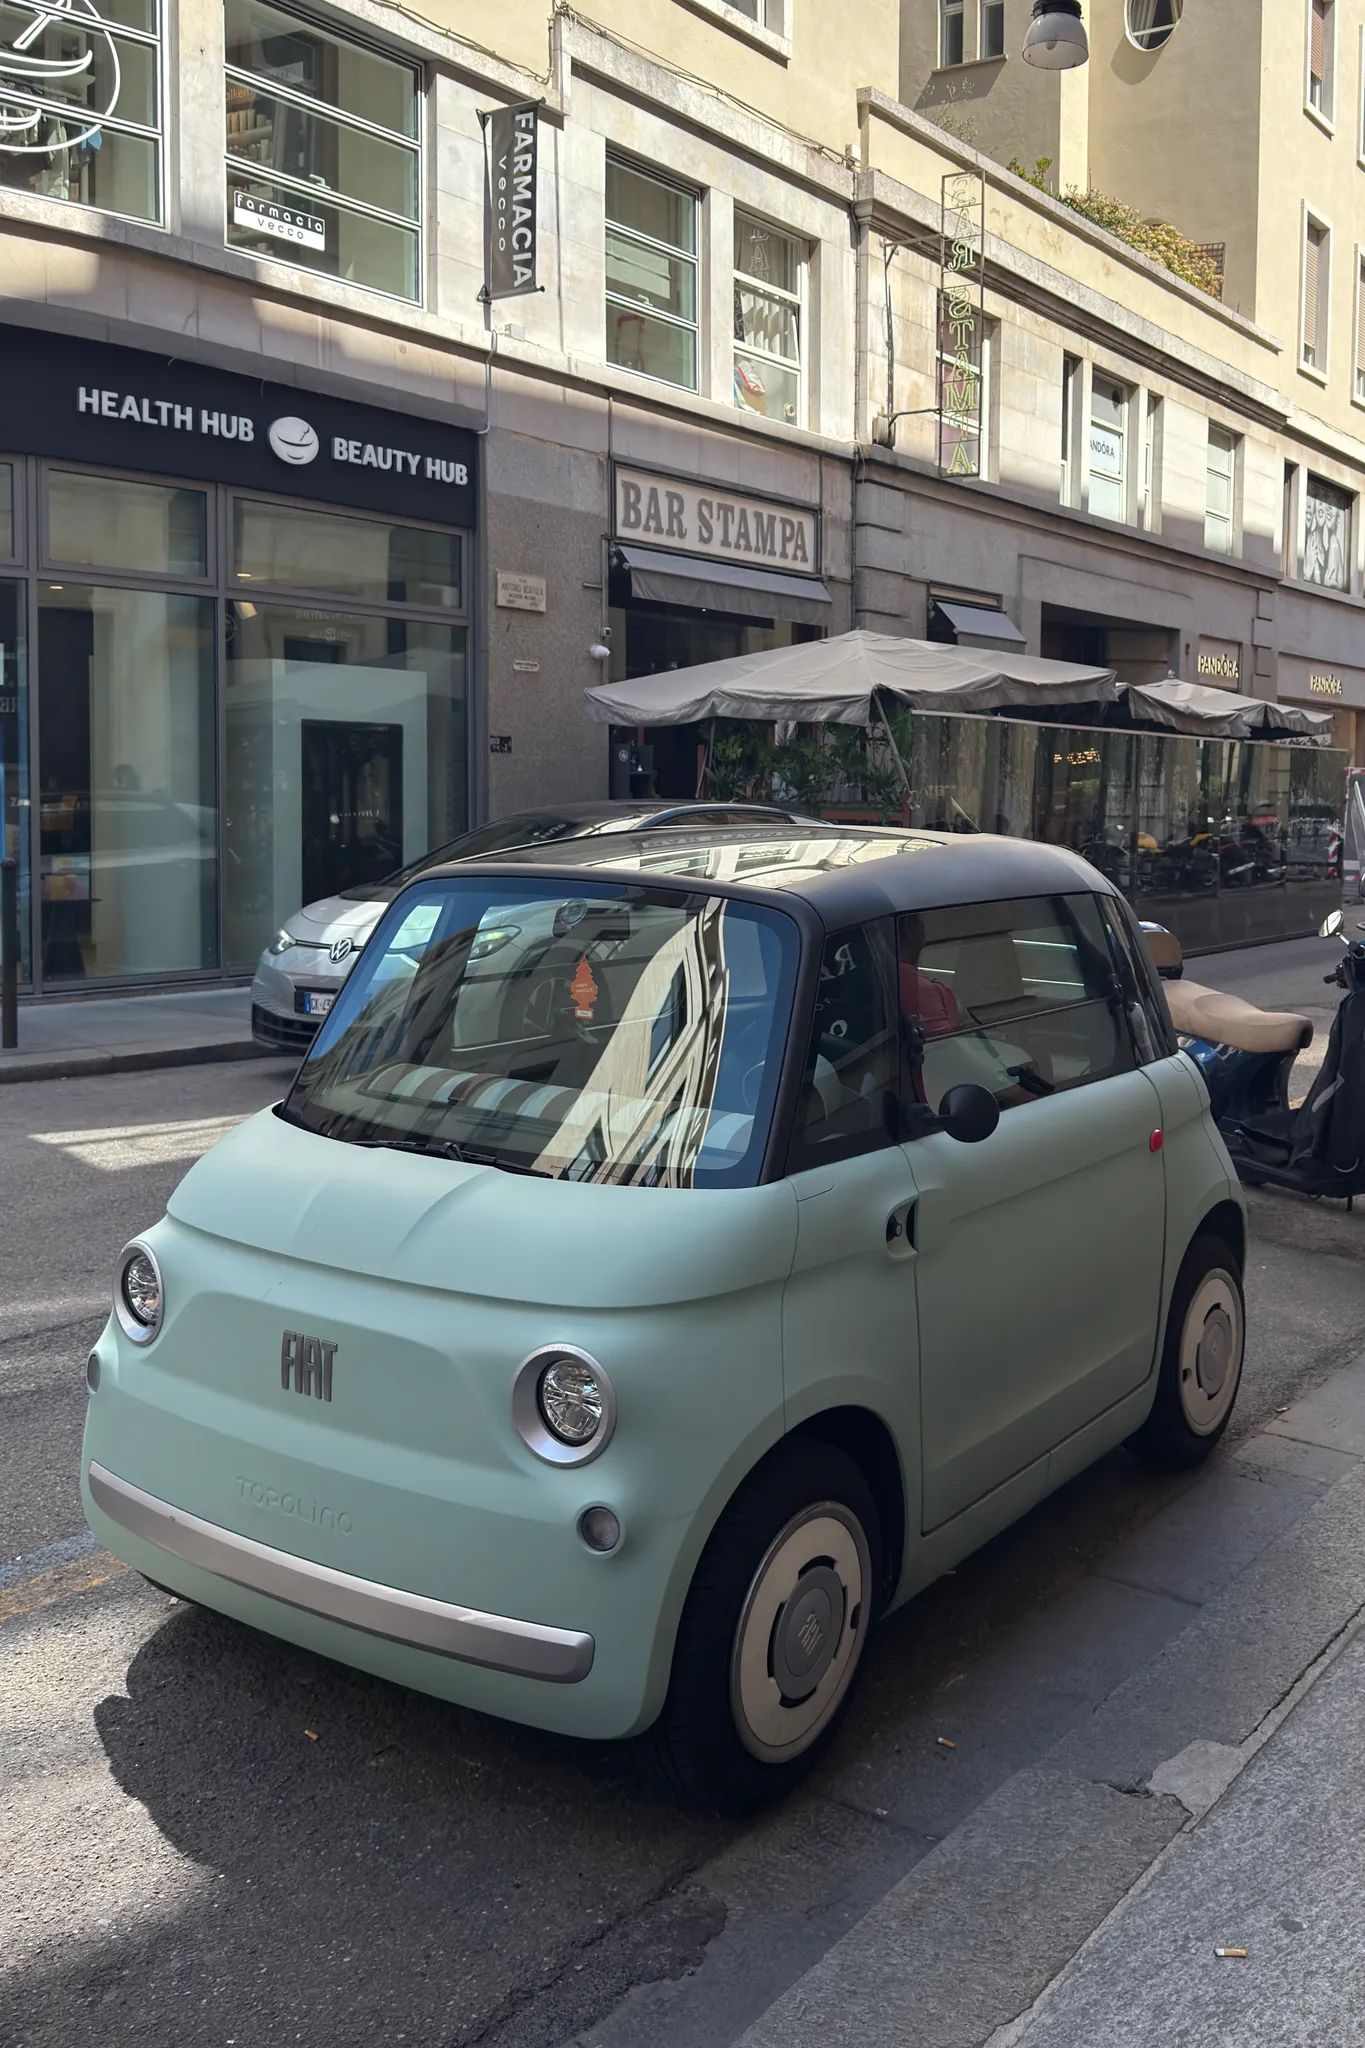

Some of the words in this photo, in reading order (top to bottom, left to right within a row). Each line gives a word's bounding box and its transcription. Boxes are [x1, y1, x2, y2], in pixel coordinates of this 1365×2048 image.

[236, 194, 323, 233] farmacia
[498, 155, 507, 251] vecco
[511, 111, 534, 288] FARMACIA
[257, 217, 304, 240] vecco
[77, 386, 193, 431] HEALTH
[201, 409, 255, 442] HUB
[332, 437, 422, 475] BEAUTY
[425, 457, 469, 486] HUB
[620, 479, 688, 540] BAR
[696, 497, 809, 564] STAMPA
[1198, 653, 1240, 679] PANDORA
[1310, 674, 1343, 695] PANDORA
[281, 1329, 339, 1403] FIAT
